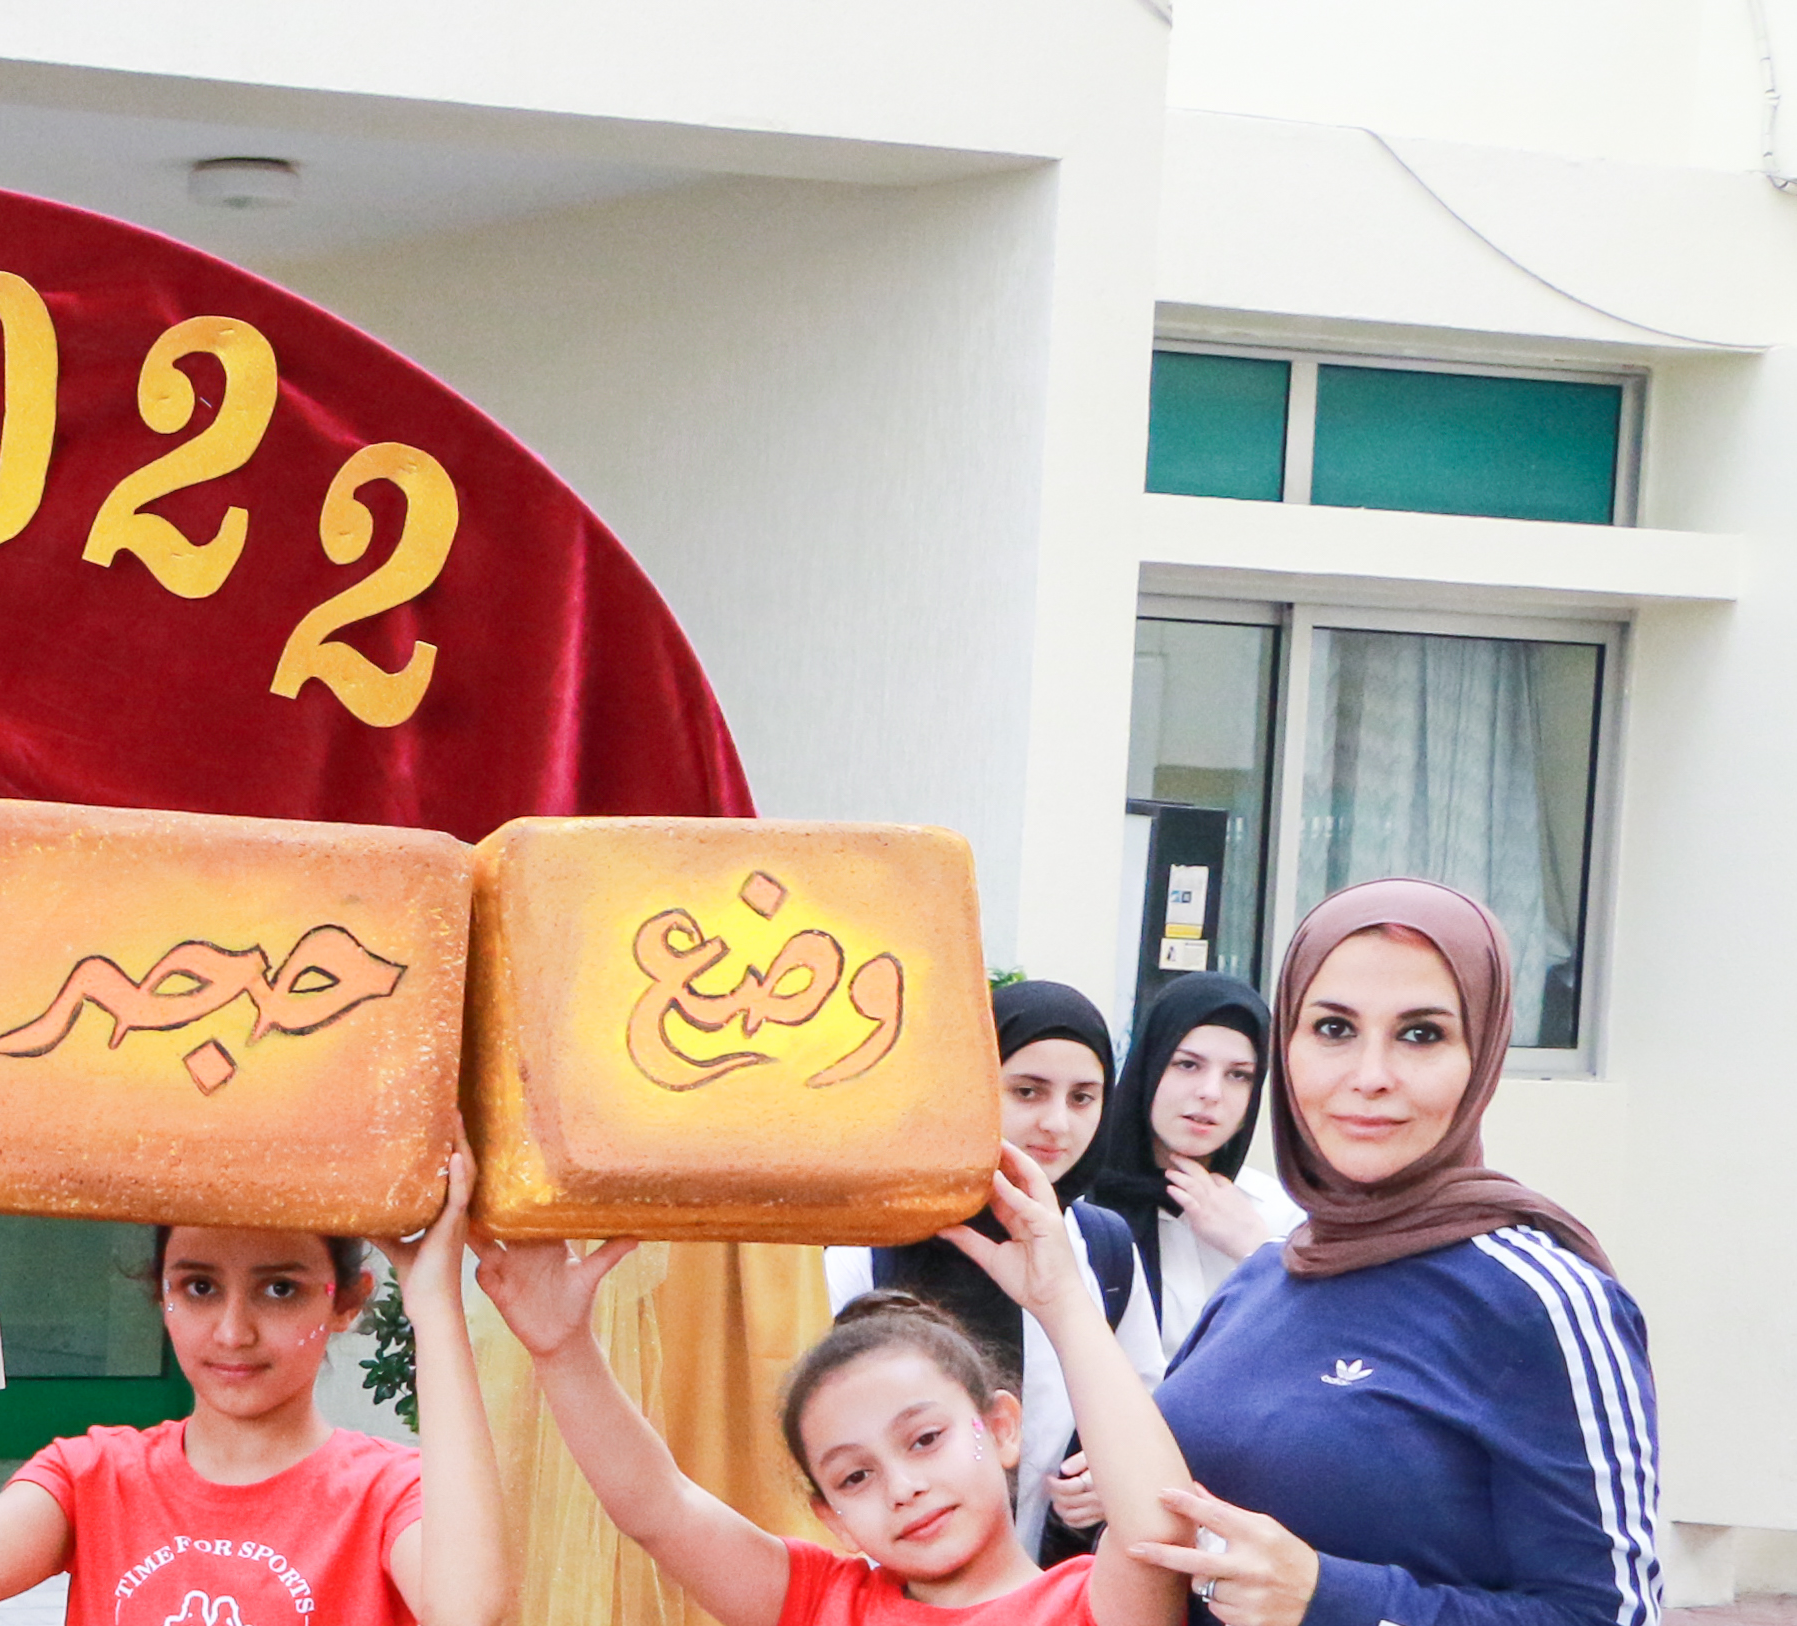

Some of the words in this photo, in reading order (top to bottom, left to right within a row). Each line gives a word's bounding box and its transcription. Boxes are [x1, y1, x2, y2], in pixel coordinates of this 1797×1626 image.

[626, 870, 904, 1092] وضع
[114, 1545, 175, 1598] TIME
[174, 1535, 232, 1556] FOR
[238, 1541, 315, 1614] SPORTS
